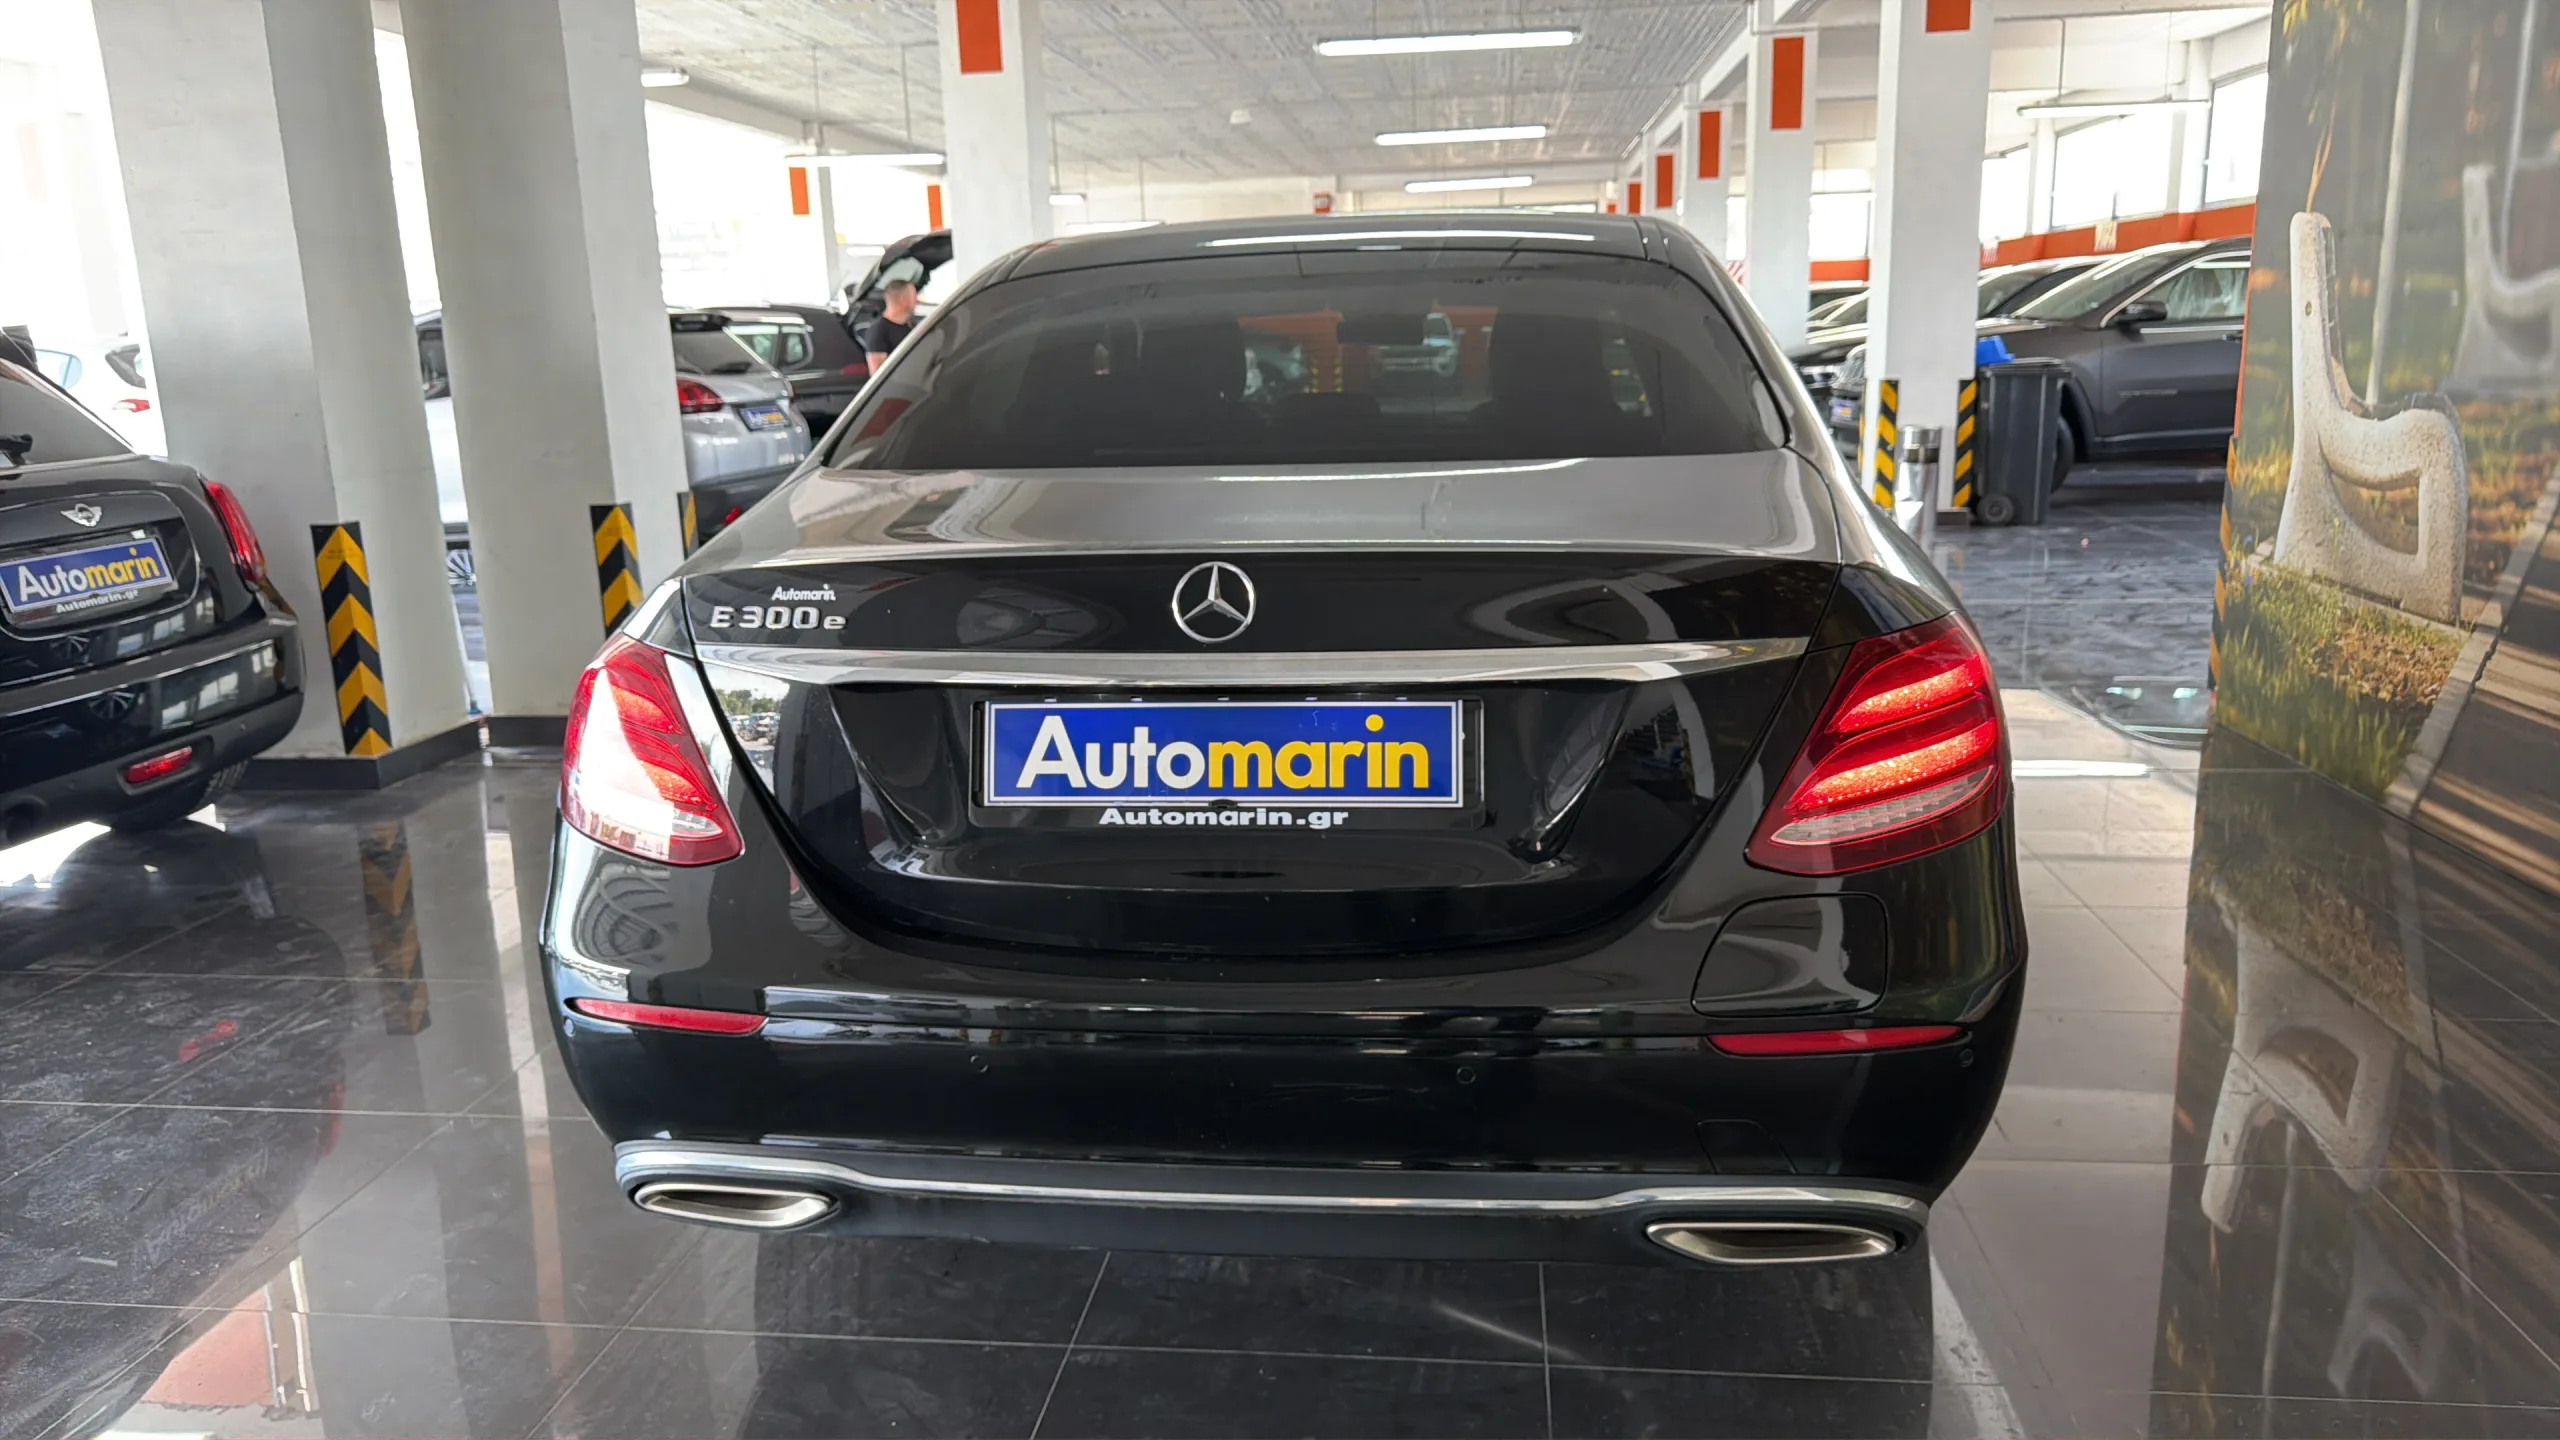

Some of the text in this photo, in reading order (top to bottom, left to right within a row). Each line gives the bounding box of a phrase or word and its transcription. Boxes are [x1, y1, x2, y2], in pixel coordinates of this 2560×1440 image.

[18, 547, 160, 602] Automarin
[56, 588, 139, 613] Automarin.gr
[1016, 714, 1430, 789] Automarin
[1099, 808, 1350, 830] Automarin.gr
